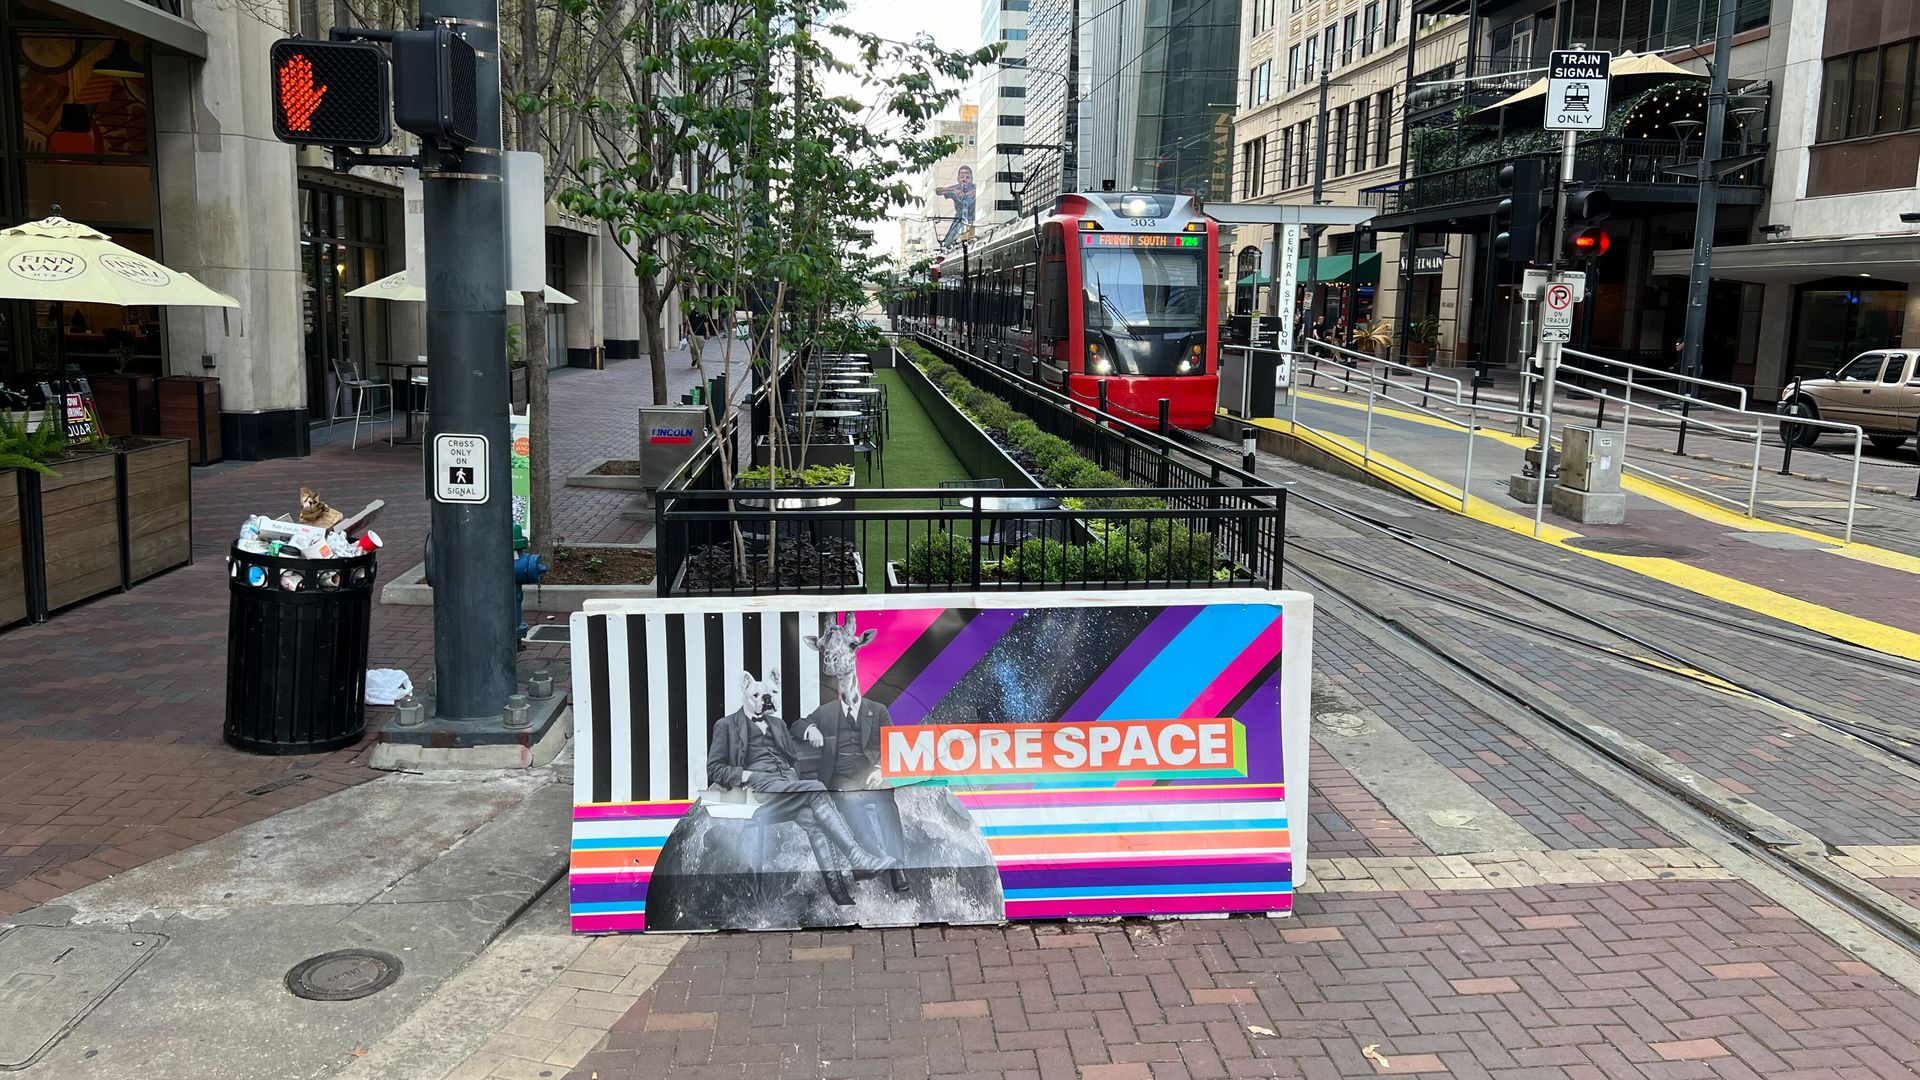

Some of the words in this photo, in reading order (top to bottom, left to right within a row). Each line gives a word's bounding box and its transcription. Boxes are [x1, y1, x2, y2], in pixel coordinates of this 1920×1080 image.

[1560, 54, 1601, 65] TRAIN
[1554, 67, 1604, 78] SIGNAL
[1557, 114, 1593, 124] ONLY
[1130, 219, 1156, 227] 303
[1099, 235, 1134, 246] FANNIN
[1138, 235, 1167, 246] SOUTH
[22, 255, 74, 265] FINN
[1286, 229, 1295, 286] CENTRAL
[105, 259, 148, 269] FINN
[18, 264, 75, 275] HALL
[118, 269, 164, 280] HALL
[1281, 290, 1291, 346] STATION
[1546, 317, 1569, 325] TRACKS
[67, 407, 83, 417] IRING
[652, 428, 693, 437] LINCOLN
[447, 440, 475, 448] CROSS
[447, 487, 476, 495] SIGNAL
[887, 728, 1043, 772] MORE
[1053, 723, 1228, 767] SPACE
